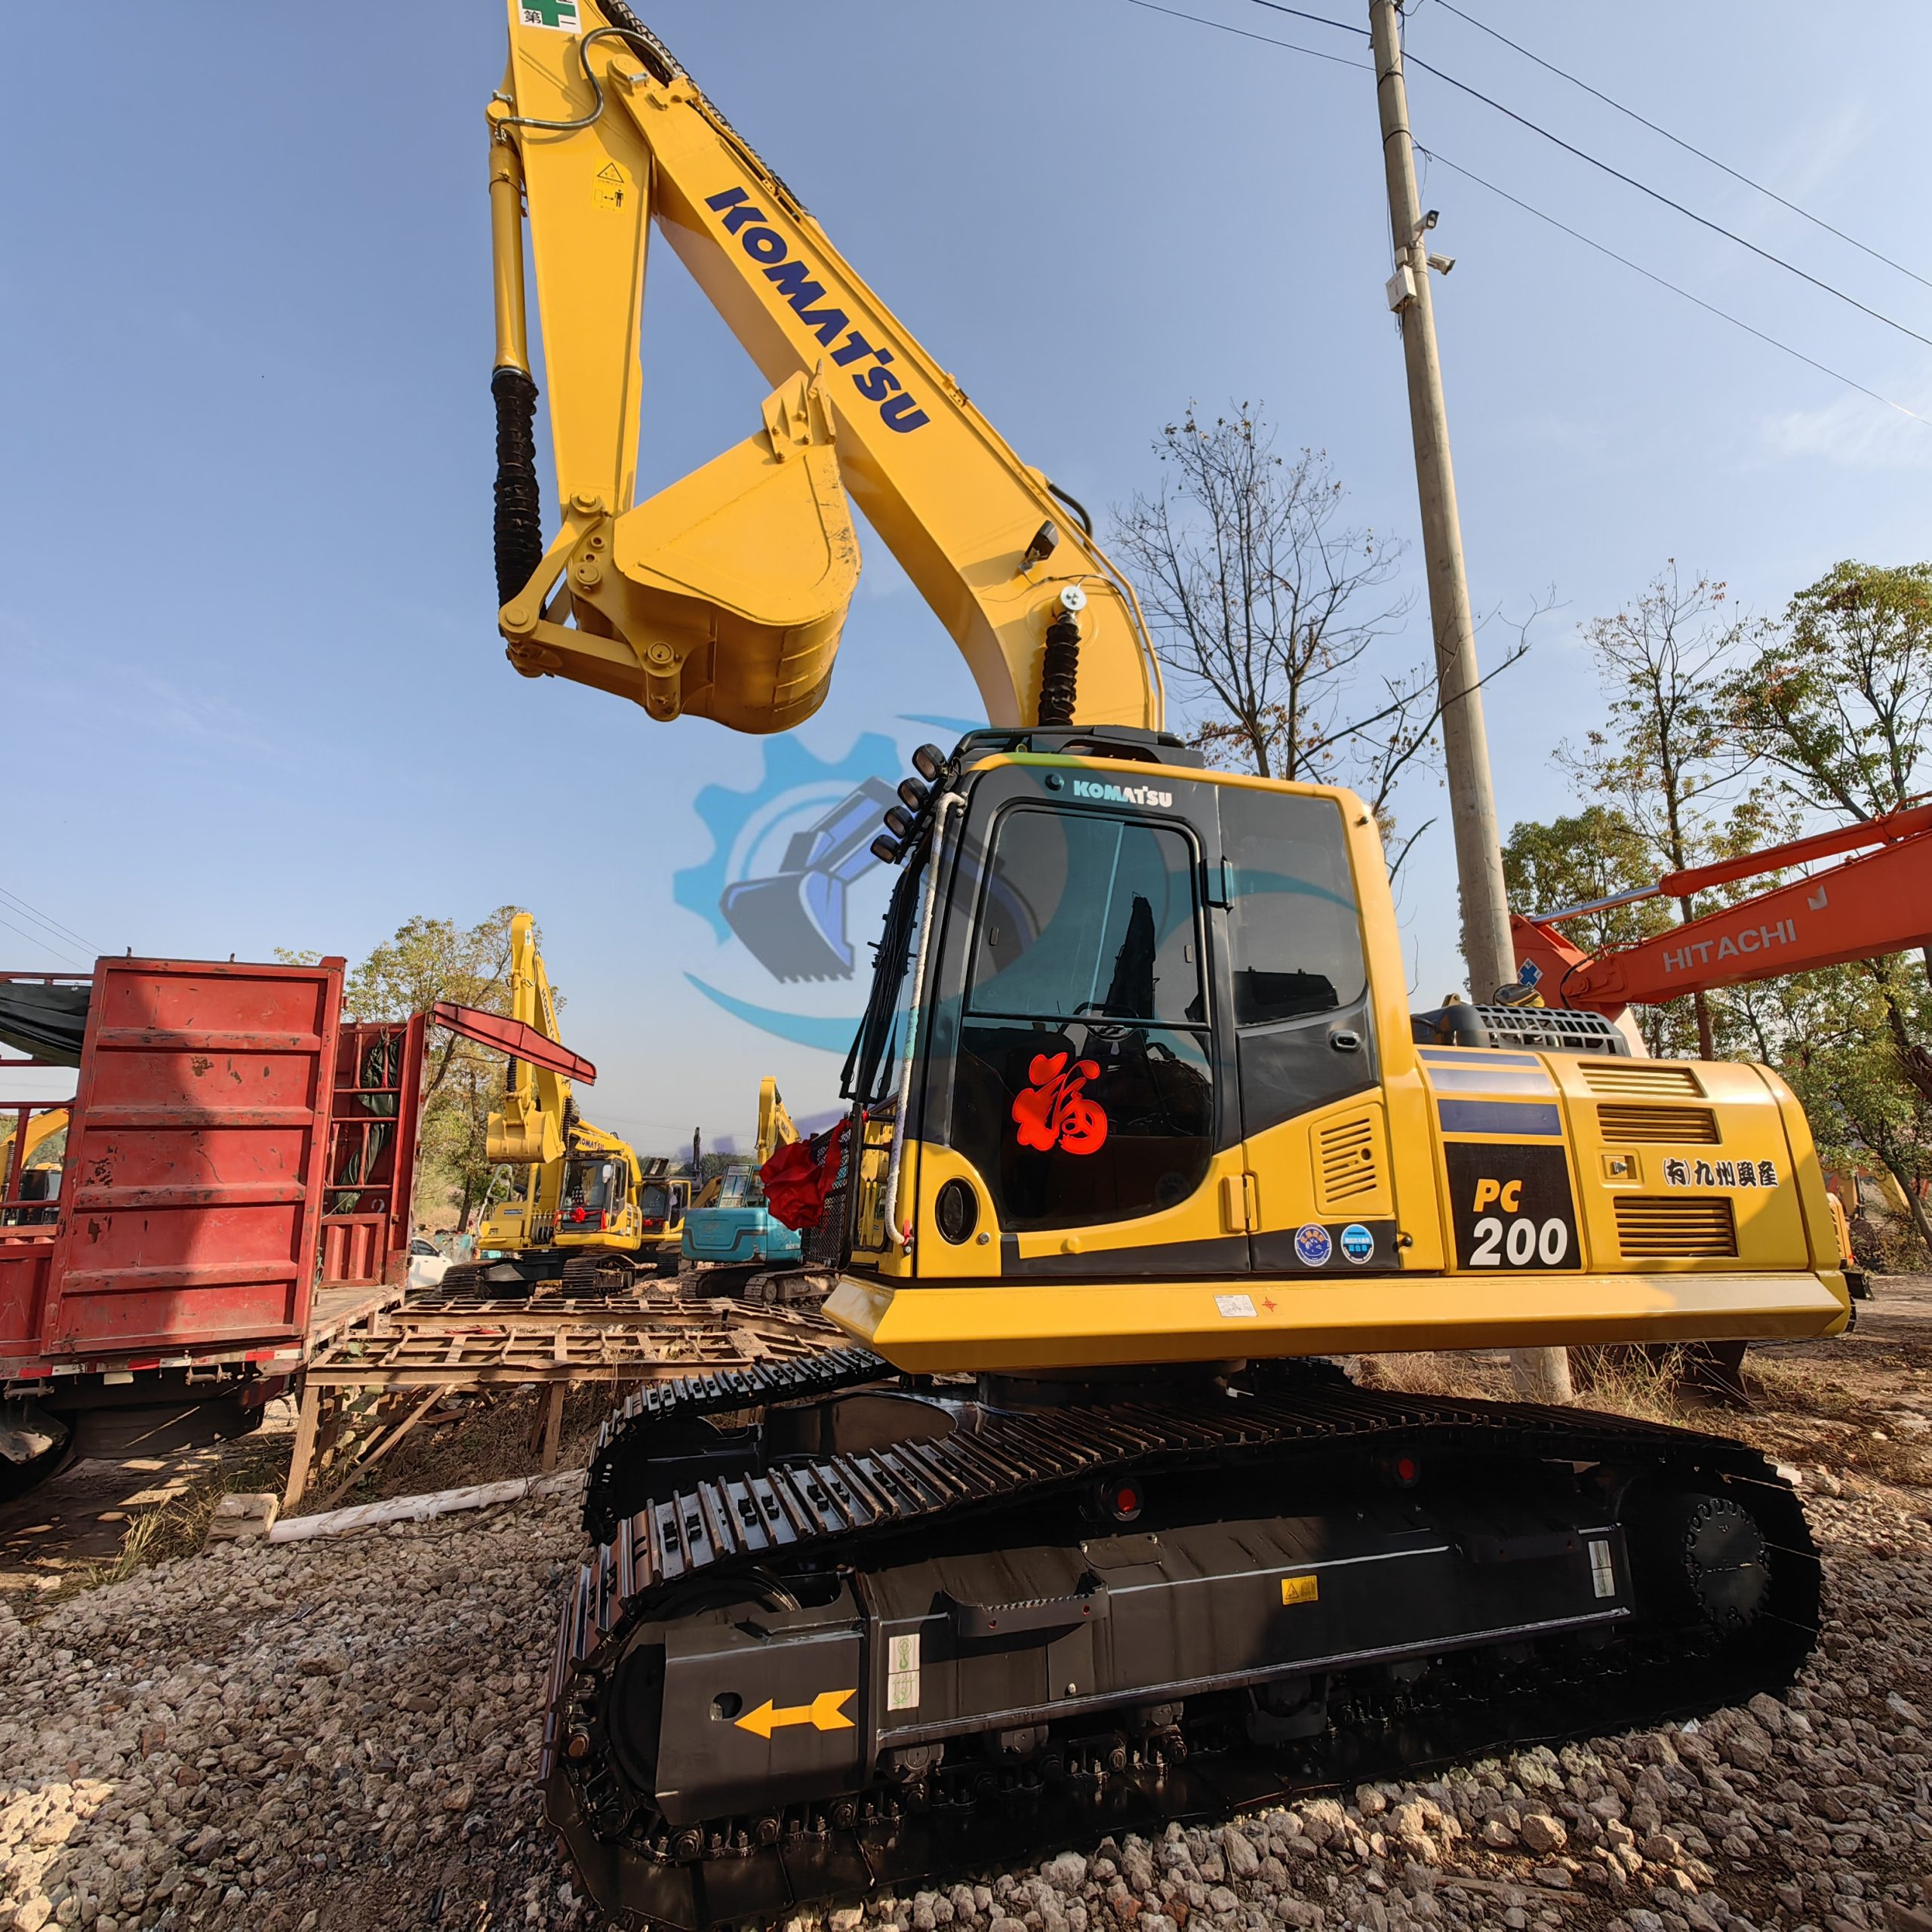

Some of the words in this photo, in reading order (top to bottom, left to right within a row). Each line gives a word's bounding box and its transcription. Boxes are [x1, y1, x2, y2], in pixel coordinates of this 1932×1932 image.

[704, 186, 931, 433] KOMATSU
[1073, 780, 1173, 808] KOMATSU
[1663, 918, 1797, 973] HITACHI
[1012, 1052, 1108, 1155] 福
[1473, 1178, 1522, 1213] PC
[1469, 1217, 1567, 1266] 200
